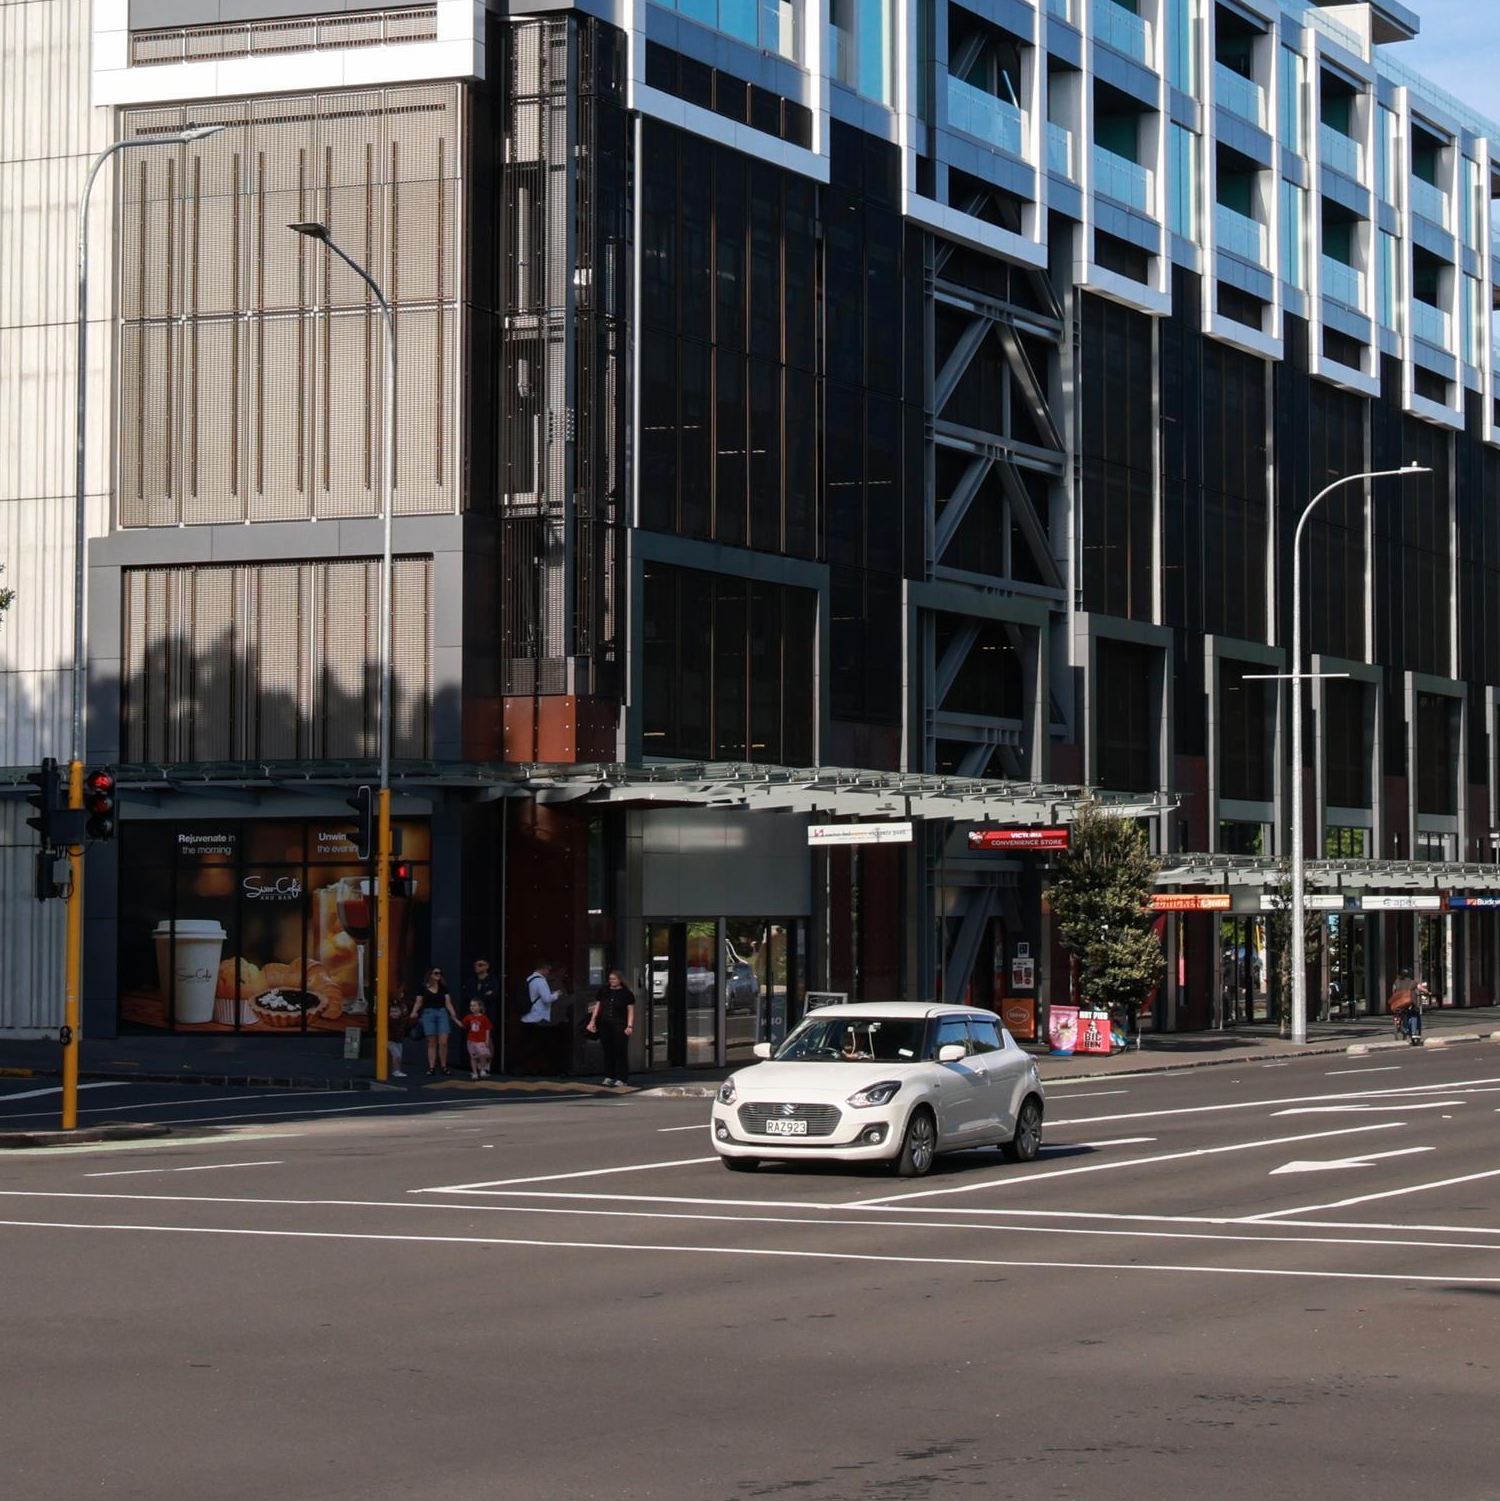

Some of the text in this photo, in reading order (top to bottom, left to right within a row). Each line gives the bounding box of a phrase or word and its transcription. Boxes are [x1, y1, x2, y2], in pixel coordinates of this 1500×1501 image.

[178, 834, 236, 844] Rejuvenate in
[318, 832, 347, 841] Unwin
[182, 846, 232, 856] the morning
[317, 844, 360, 853] the evenin
[1393, 898, 1417, 908] apex
[1084, 1033, 1101, 1041] BIG
[767, 1121, 806, 1133] RAZ923
